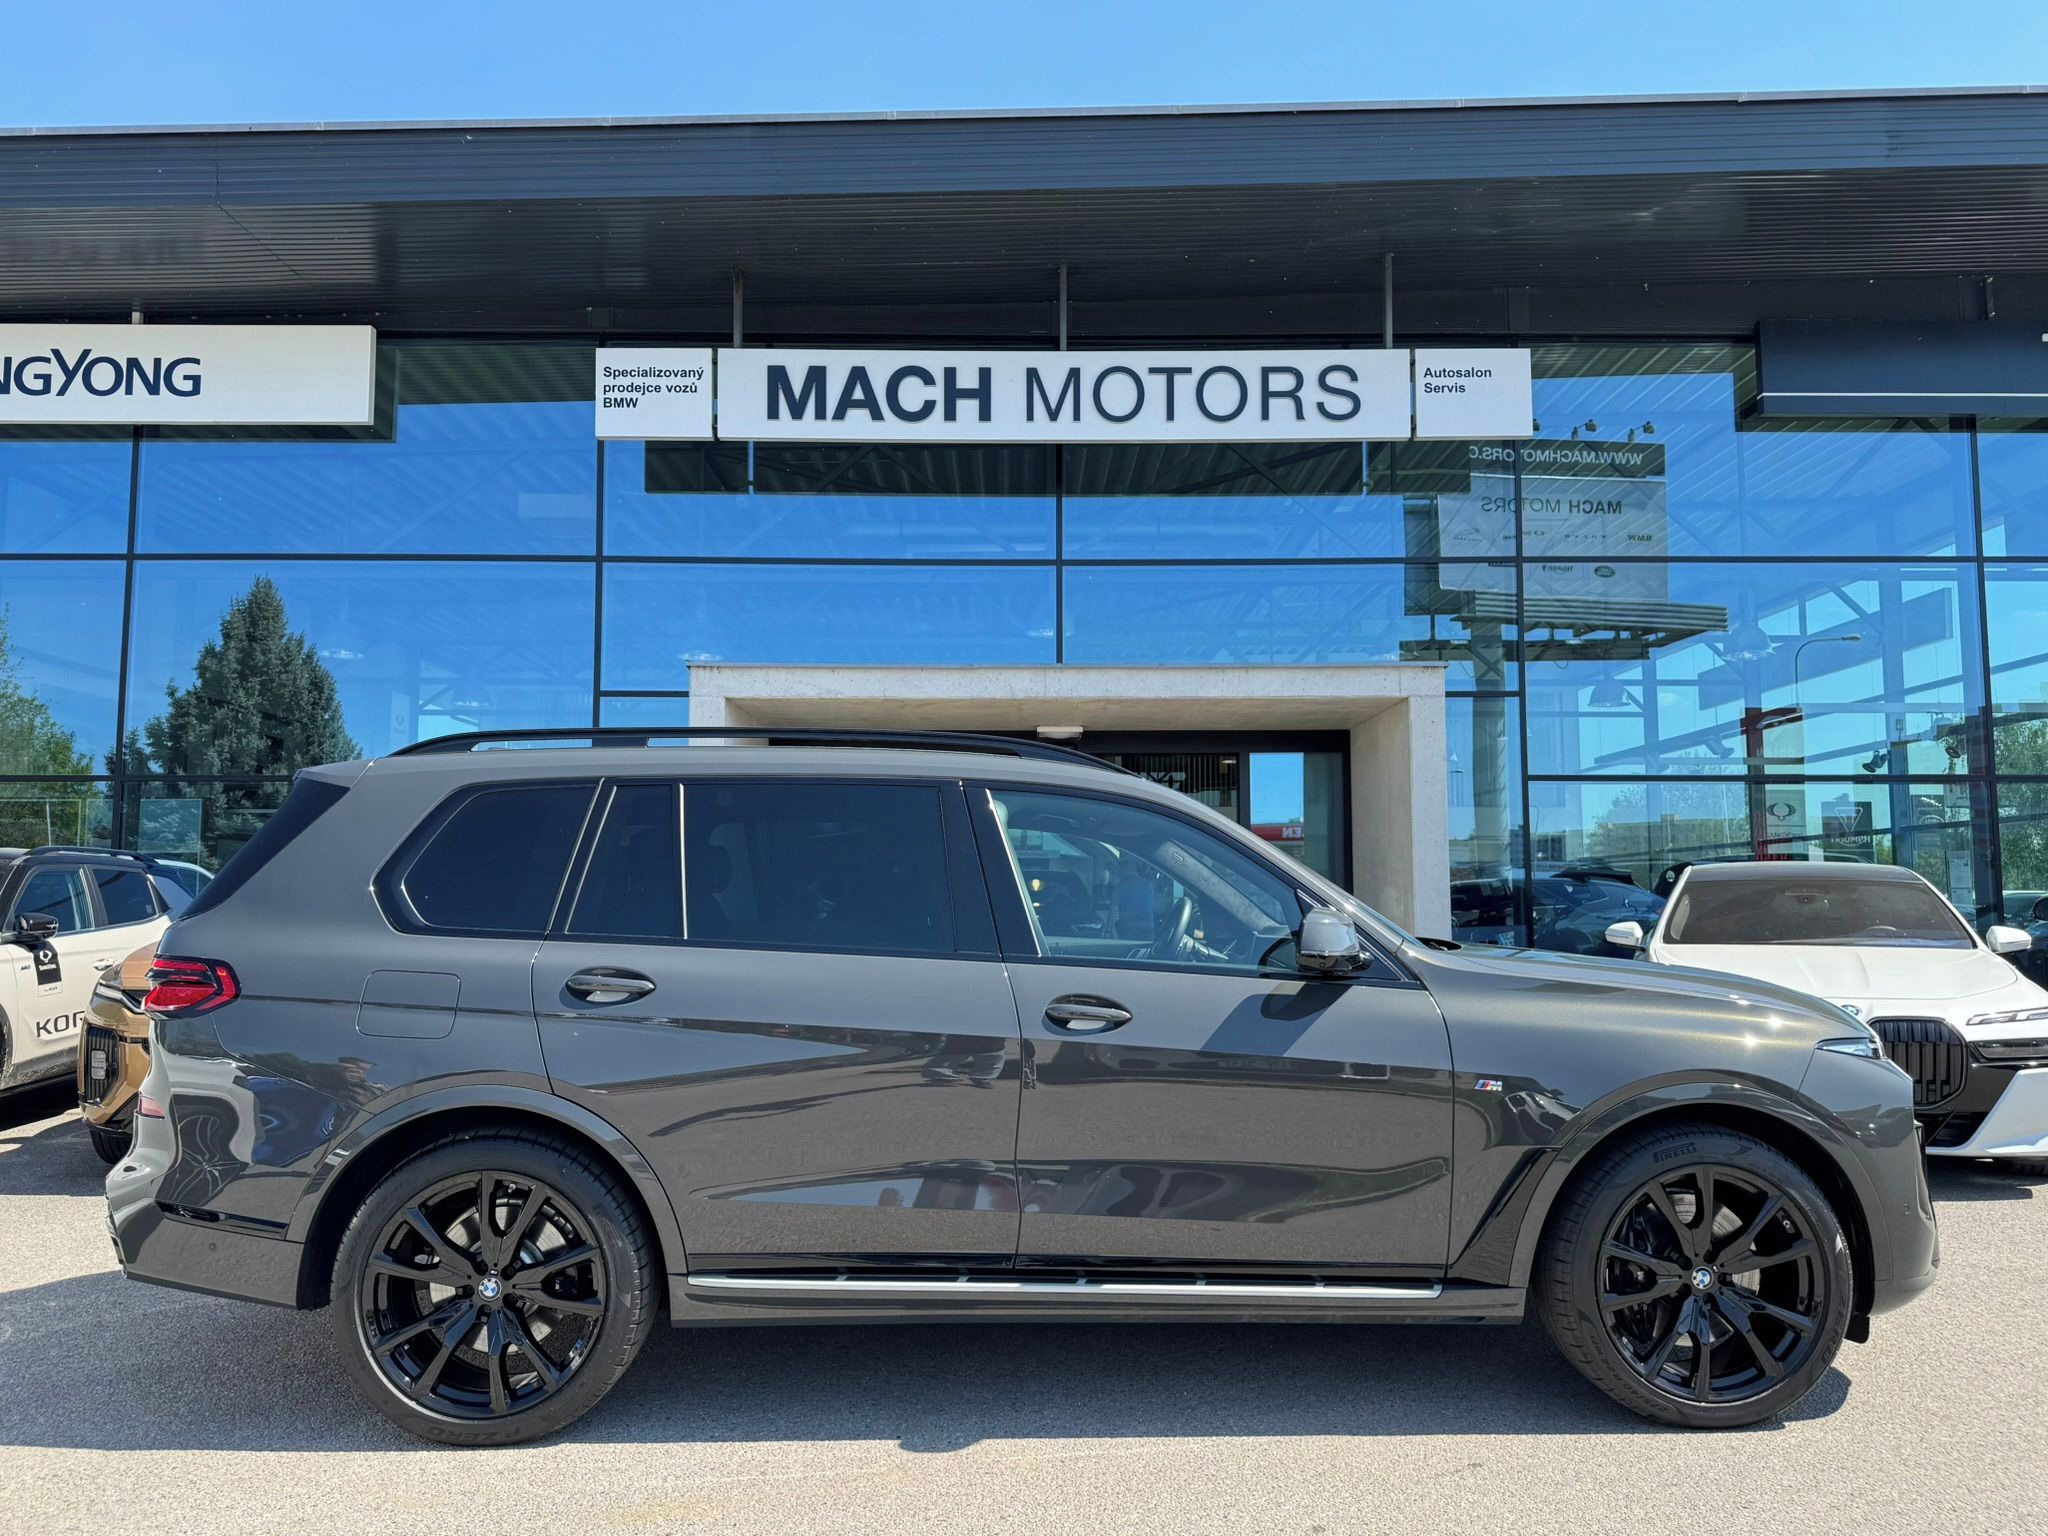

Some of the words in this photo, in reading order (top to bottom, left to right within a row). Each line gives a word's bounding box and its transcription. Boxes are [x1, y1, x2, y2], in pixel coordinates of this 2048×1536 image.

[603, 366, 704, 380] Specializovaný
[1423, 367, 1492, 378] Autosalon
[603, 382, 661, 395] prodejce
[665, 382, 698, 393] vozů
[766, 364, 992, 422] MACH
[1026, 364, 1362, 423] MOTORS
[1424, 382, 1466, 393] Servis
[603, 397, 638, 408] BMW
